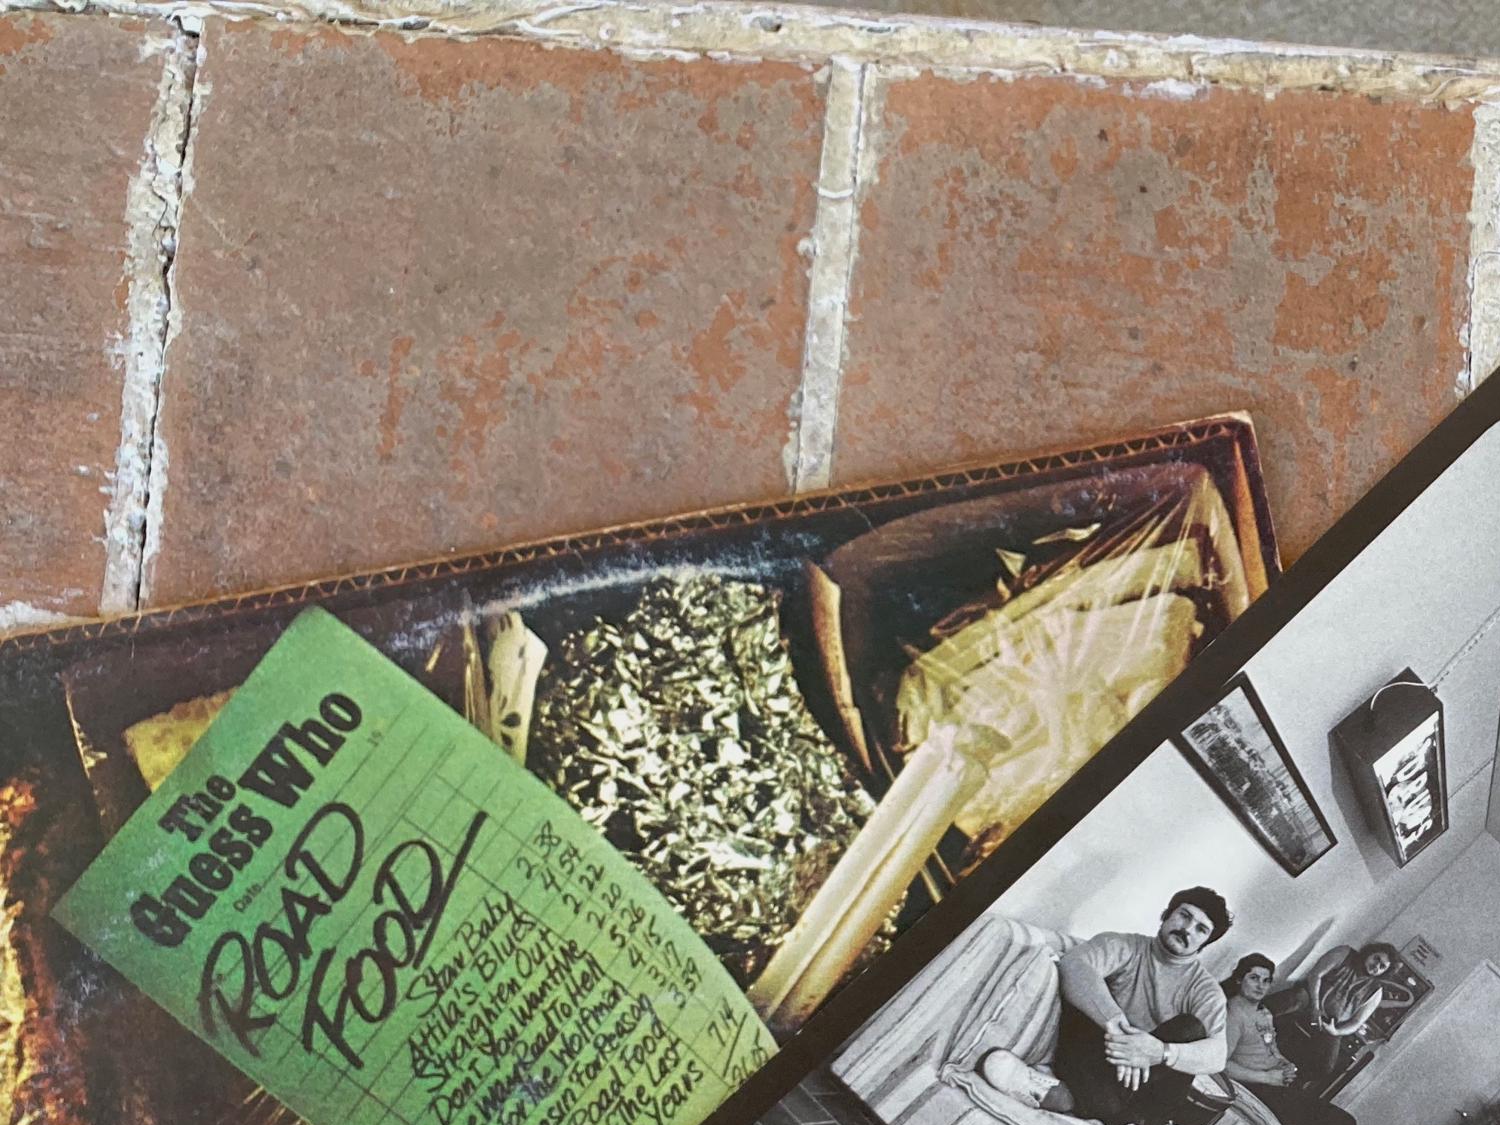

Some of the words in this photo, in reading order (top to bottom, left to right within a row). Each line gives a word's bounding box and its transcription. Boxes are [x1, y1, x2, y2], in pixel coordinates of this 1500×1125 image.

[130, 804, 273, 947] Guess
[237, 692, 362, 808] Who
[158, 775, 237, 842] The
[198, 803, 365, 1059] ROAD
[302, 825, 462, 1068] FOOD
[405, 950, 466, 1019] Star
[455, 892, 516, 956] Baby
[408, 985, 479, 1067] Attila's
[473, 911, 538, 983] Blues
[413, 972, 523, 1093] Straighten
[514, 927, 557, 980] Out
[620, 1014, 670, 1078] Food
[645, 1034, 686, 1092] Last
